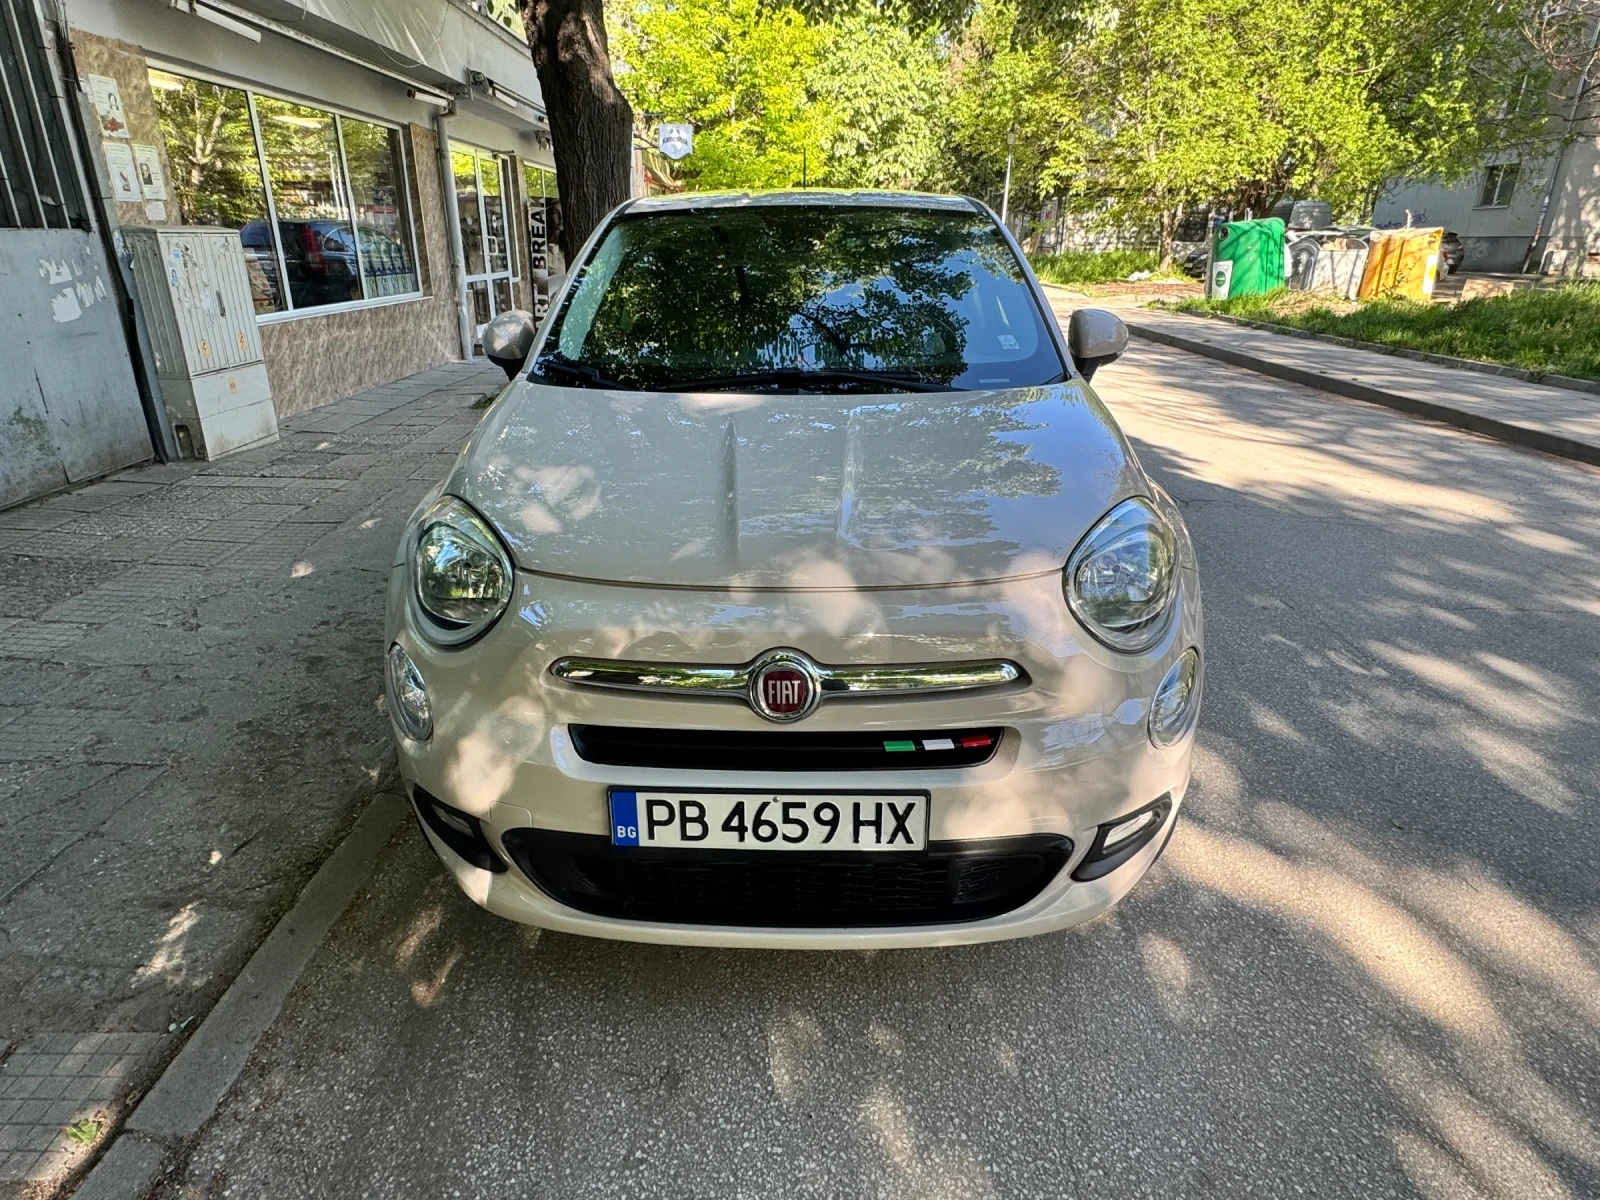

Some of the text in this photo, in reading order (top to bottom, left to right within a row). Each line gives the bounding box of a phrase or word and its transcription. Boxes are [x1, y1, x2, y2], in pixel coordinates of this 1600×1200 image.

[530, 196, 547, 270] BREAK
[767, 680, 801, 705] FIAT
[617, 825, 637, 838] BG
[646, 799, 917, 845] PB 4659 HX
